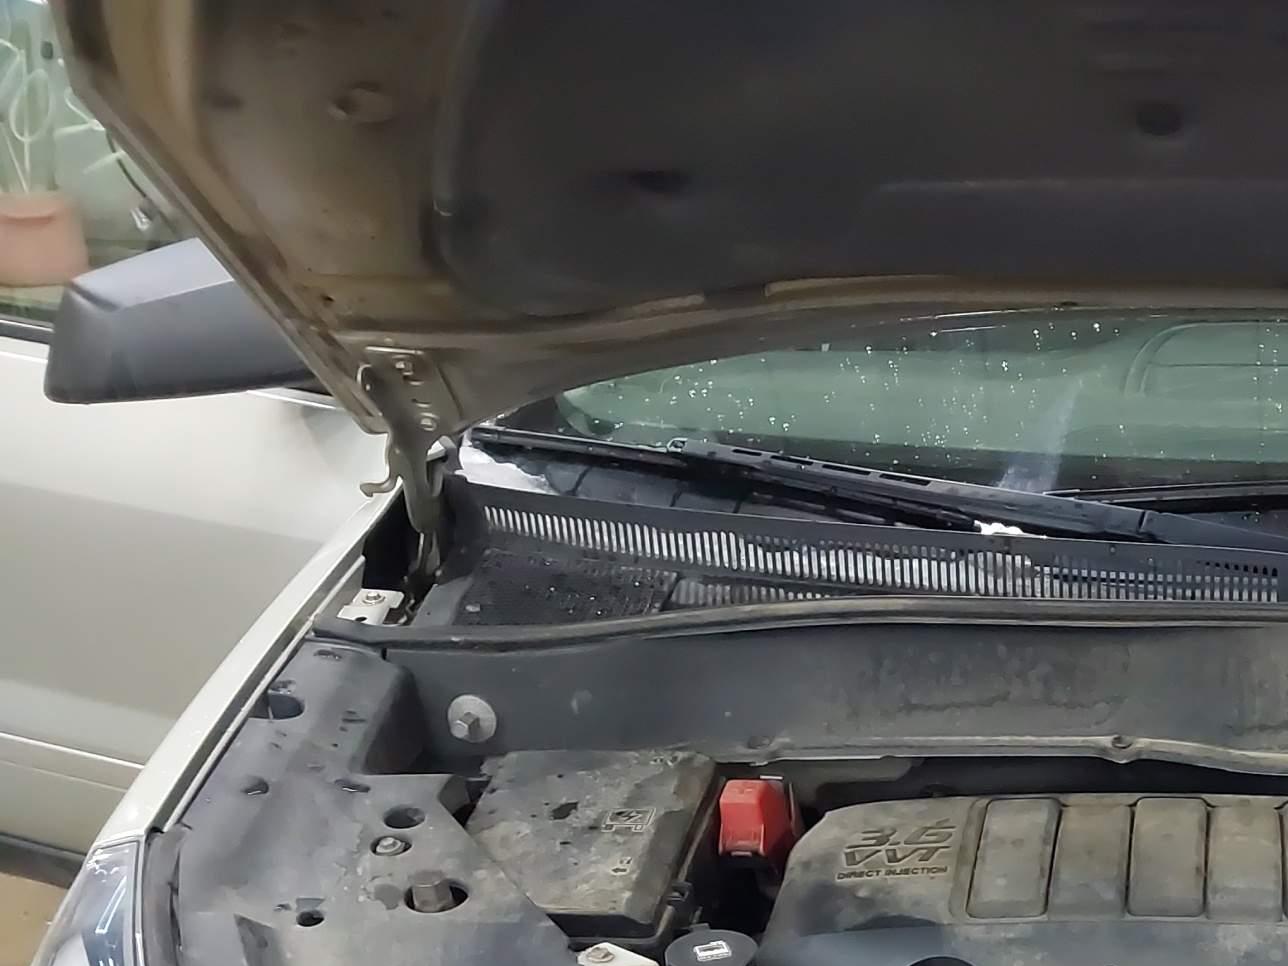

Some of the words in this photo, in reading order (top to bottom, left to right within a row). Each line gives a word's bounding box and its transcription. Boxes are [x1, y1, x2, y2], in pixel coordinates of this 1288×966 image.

[847, 819, 956, 849] 3.6
[844, 845, 952, 866] VVT
[837, 869, 881, 880] DIRECT
[885, 866, 948, 878] INJECTION
